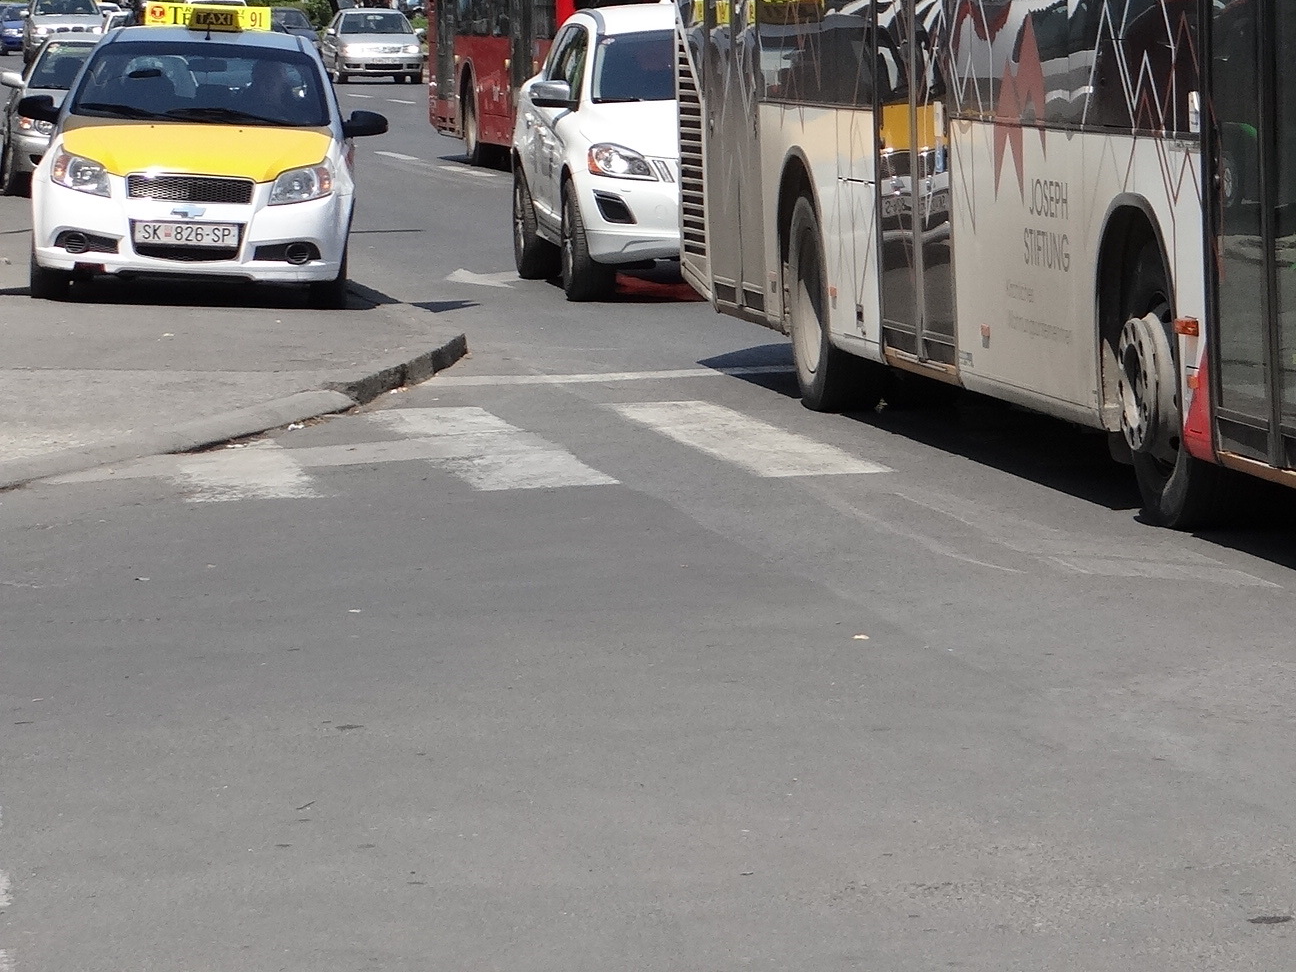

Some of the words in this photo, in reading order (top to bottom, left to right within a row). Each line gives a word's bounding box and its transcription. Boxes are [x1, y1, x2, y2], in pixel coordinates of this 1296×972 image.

[197, 12, 232, 25] TAXI
[250, 11, 263, 27] 91
[1029, 178, 1069, 220] JOSEPH
[143, 224, 162, 240] SK
[174, 225, 232, 243] 826-SP
[1023, 227, 1071, 273] STIFTUNG
